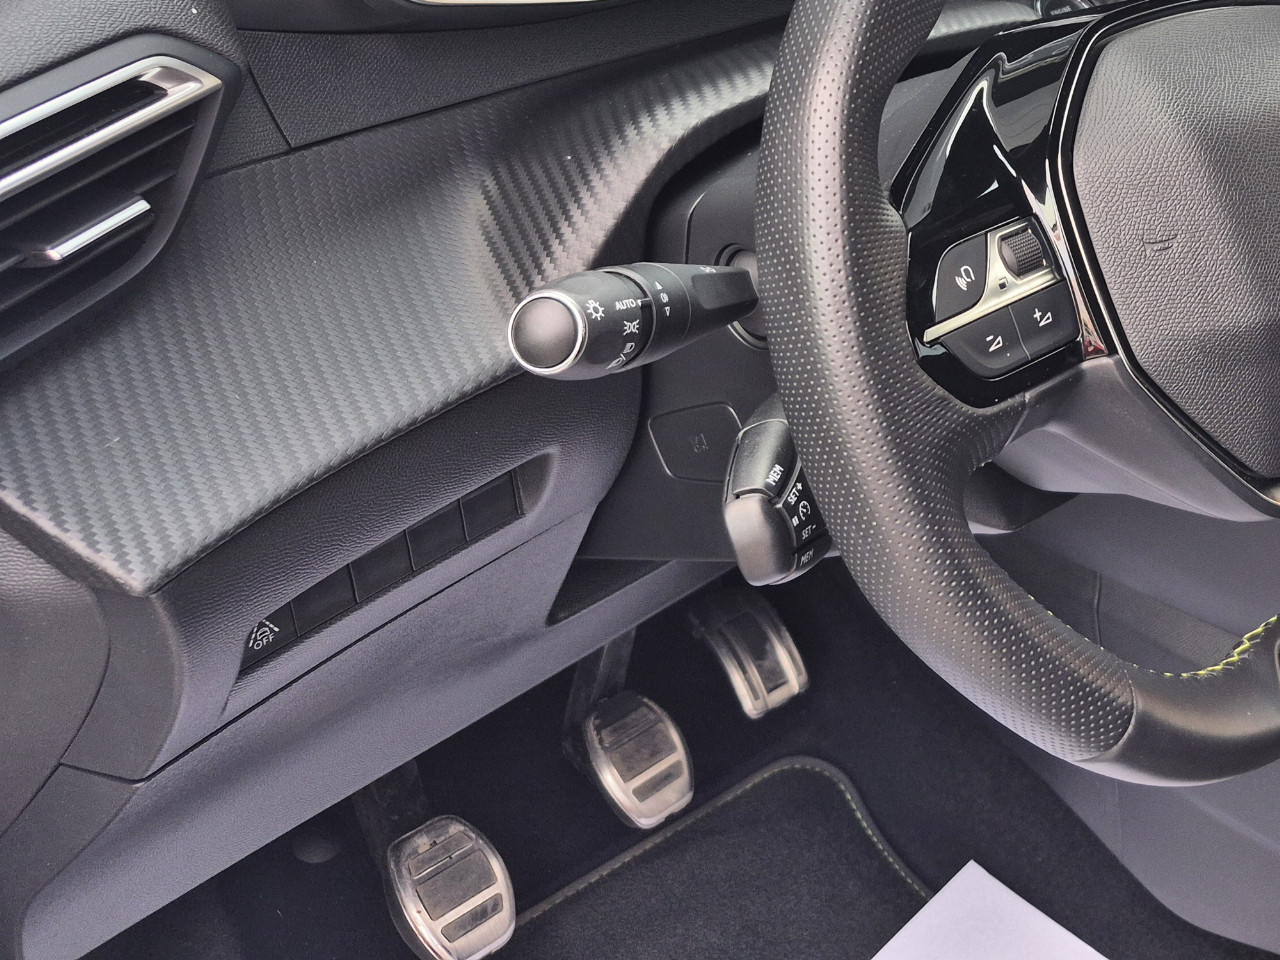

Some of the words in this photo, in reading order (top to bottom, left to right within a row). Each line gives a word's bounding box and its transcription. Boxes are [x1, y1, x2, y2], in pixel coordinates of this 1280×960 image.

[615, 298, 636, 310] AUTO
[765, 464, 784, 486] MEM
[800, 548, 814, 566] MEM
[254, 633, 275, 650] OFF
